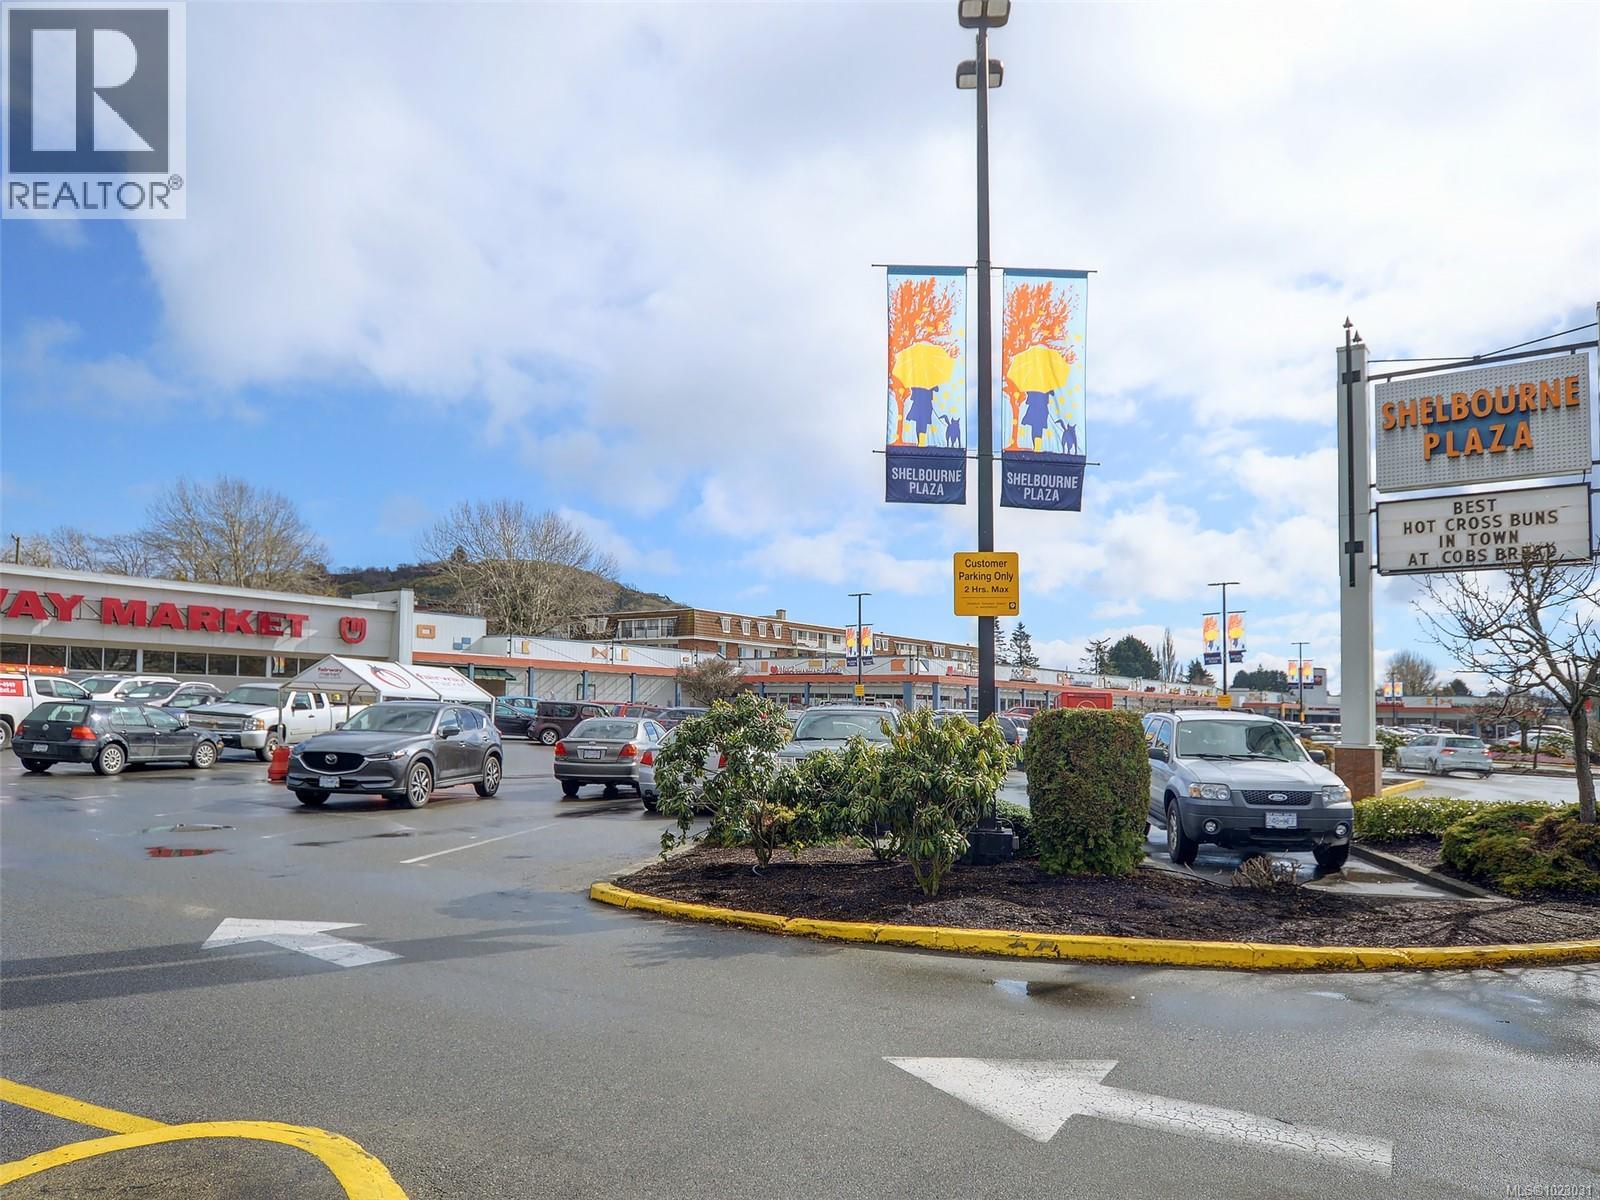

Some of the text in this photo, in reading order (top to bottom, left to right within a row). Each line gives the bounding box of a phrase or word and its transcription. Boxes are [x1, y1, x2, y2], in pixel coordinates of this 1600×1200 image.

[1381, 375, 1581, 431] SHELBOURNE
[1423, 420, 1533, 462] PLAZA
[891, 467, 962, 483] SHELBOURNE
[1006, 471, 1079, 489] SHELBOURNE
[909, 482, 945, 496] PLAZA
[1023, 487, 1060, 502] PLAZA
[1453, 498, 1497, 516] BEST
[1403, 510, 1559, 535] HOT CROSS BUNS
[1439, 530, 1519, 549] IN TOWN
[964, 558, 1008, 568] Customer
[1408, 552, 1429, 567] AT
[1442, 548, 1488, 564] COBS
[958, 571, 1014, 583] Parking Only
[964, 585, 1009, 593] 2 Hrs. Max
[100, 597, 310, 639] MARKET
